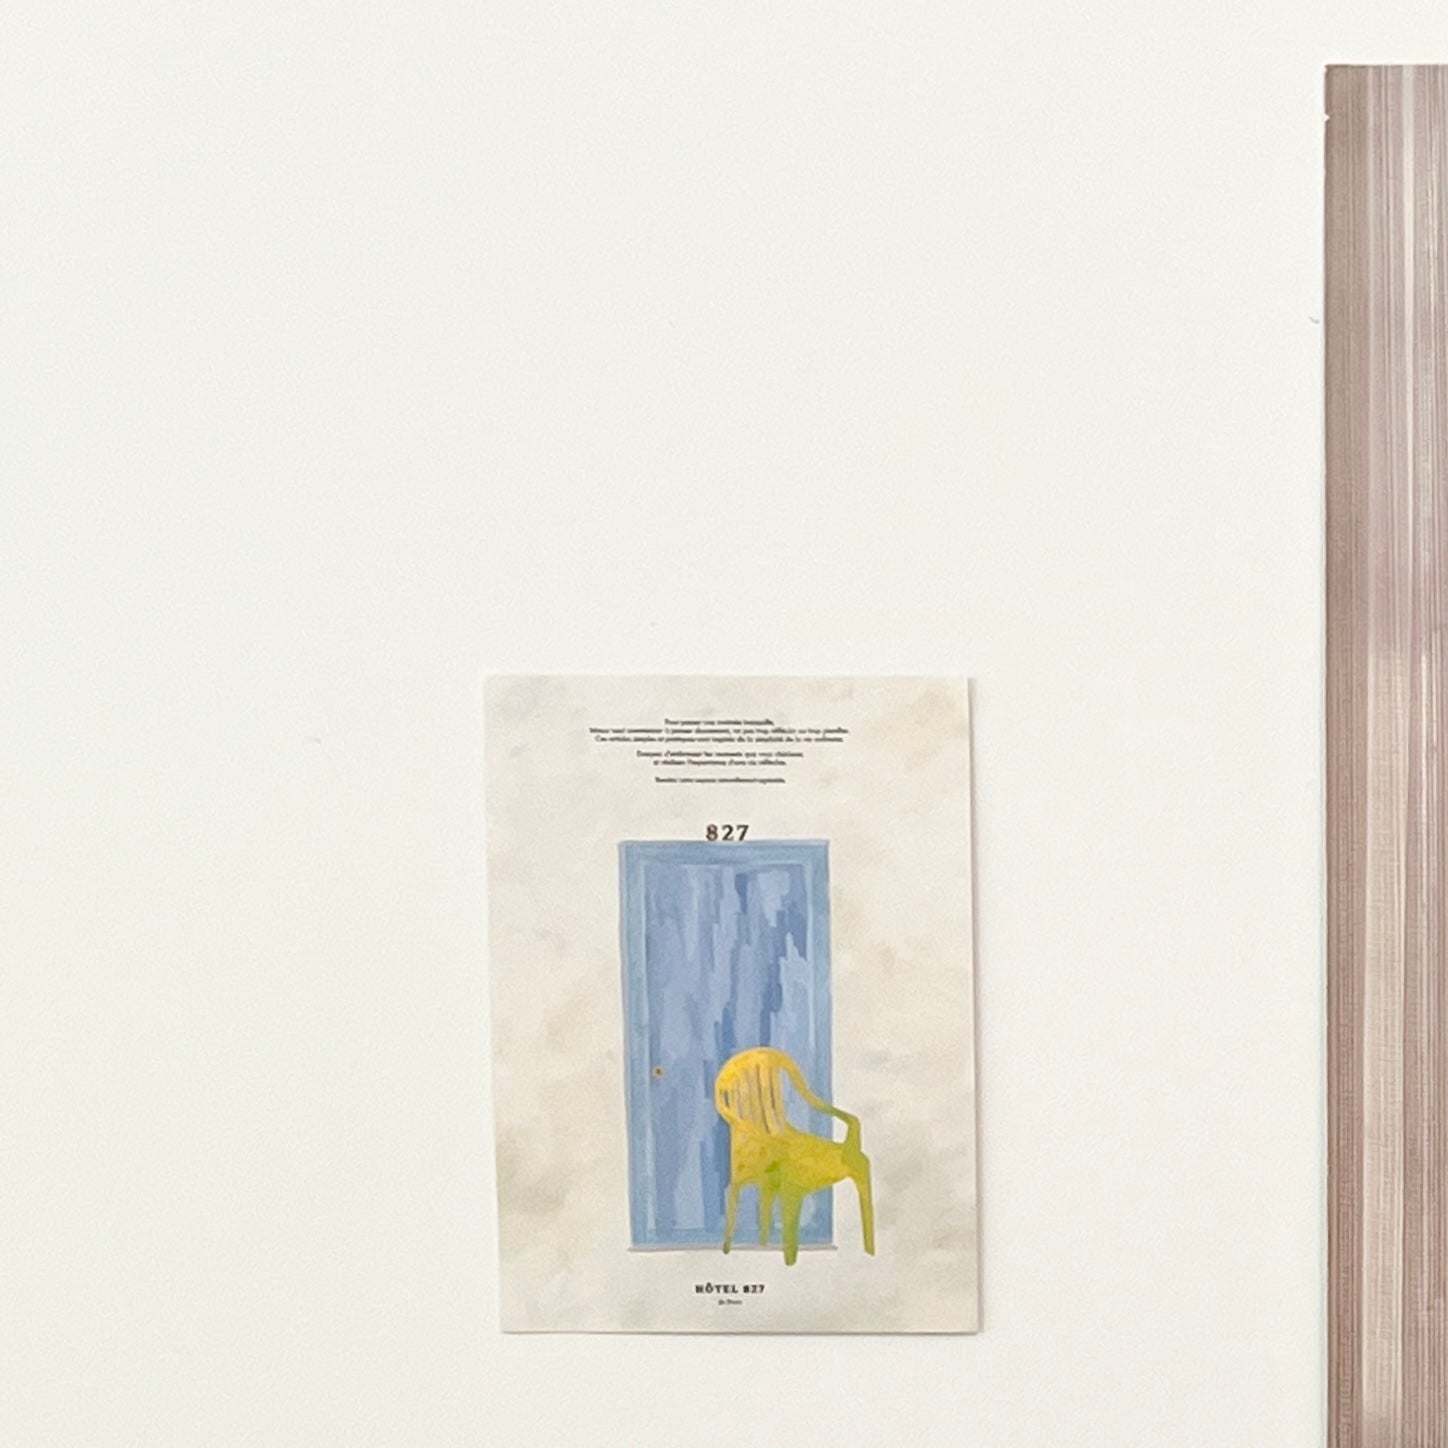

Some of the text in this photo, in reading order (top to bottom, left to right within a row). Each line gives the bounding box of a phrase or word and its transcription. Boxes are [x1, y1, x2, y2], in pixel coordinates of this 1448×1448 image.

[706, 824, 749, 841] 827
[695, 1282, 765, 1293] HÔTEL 827
